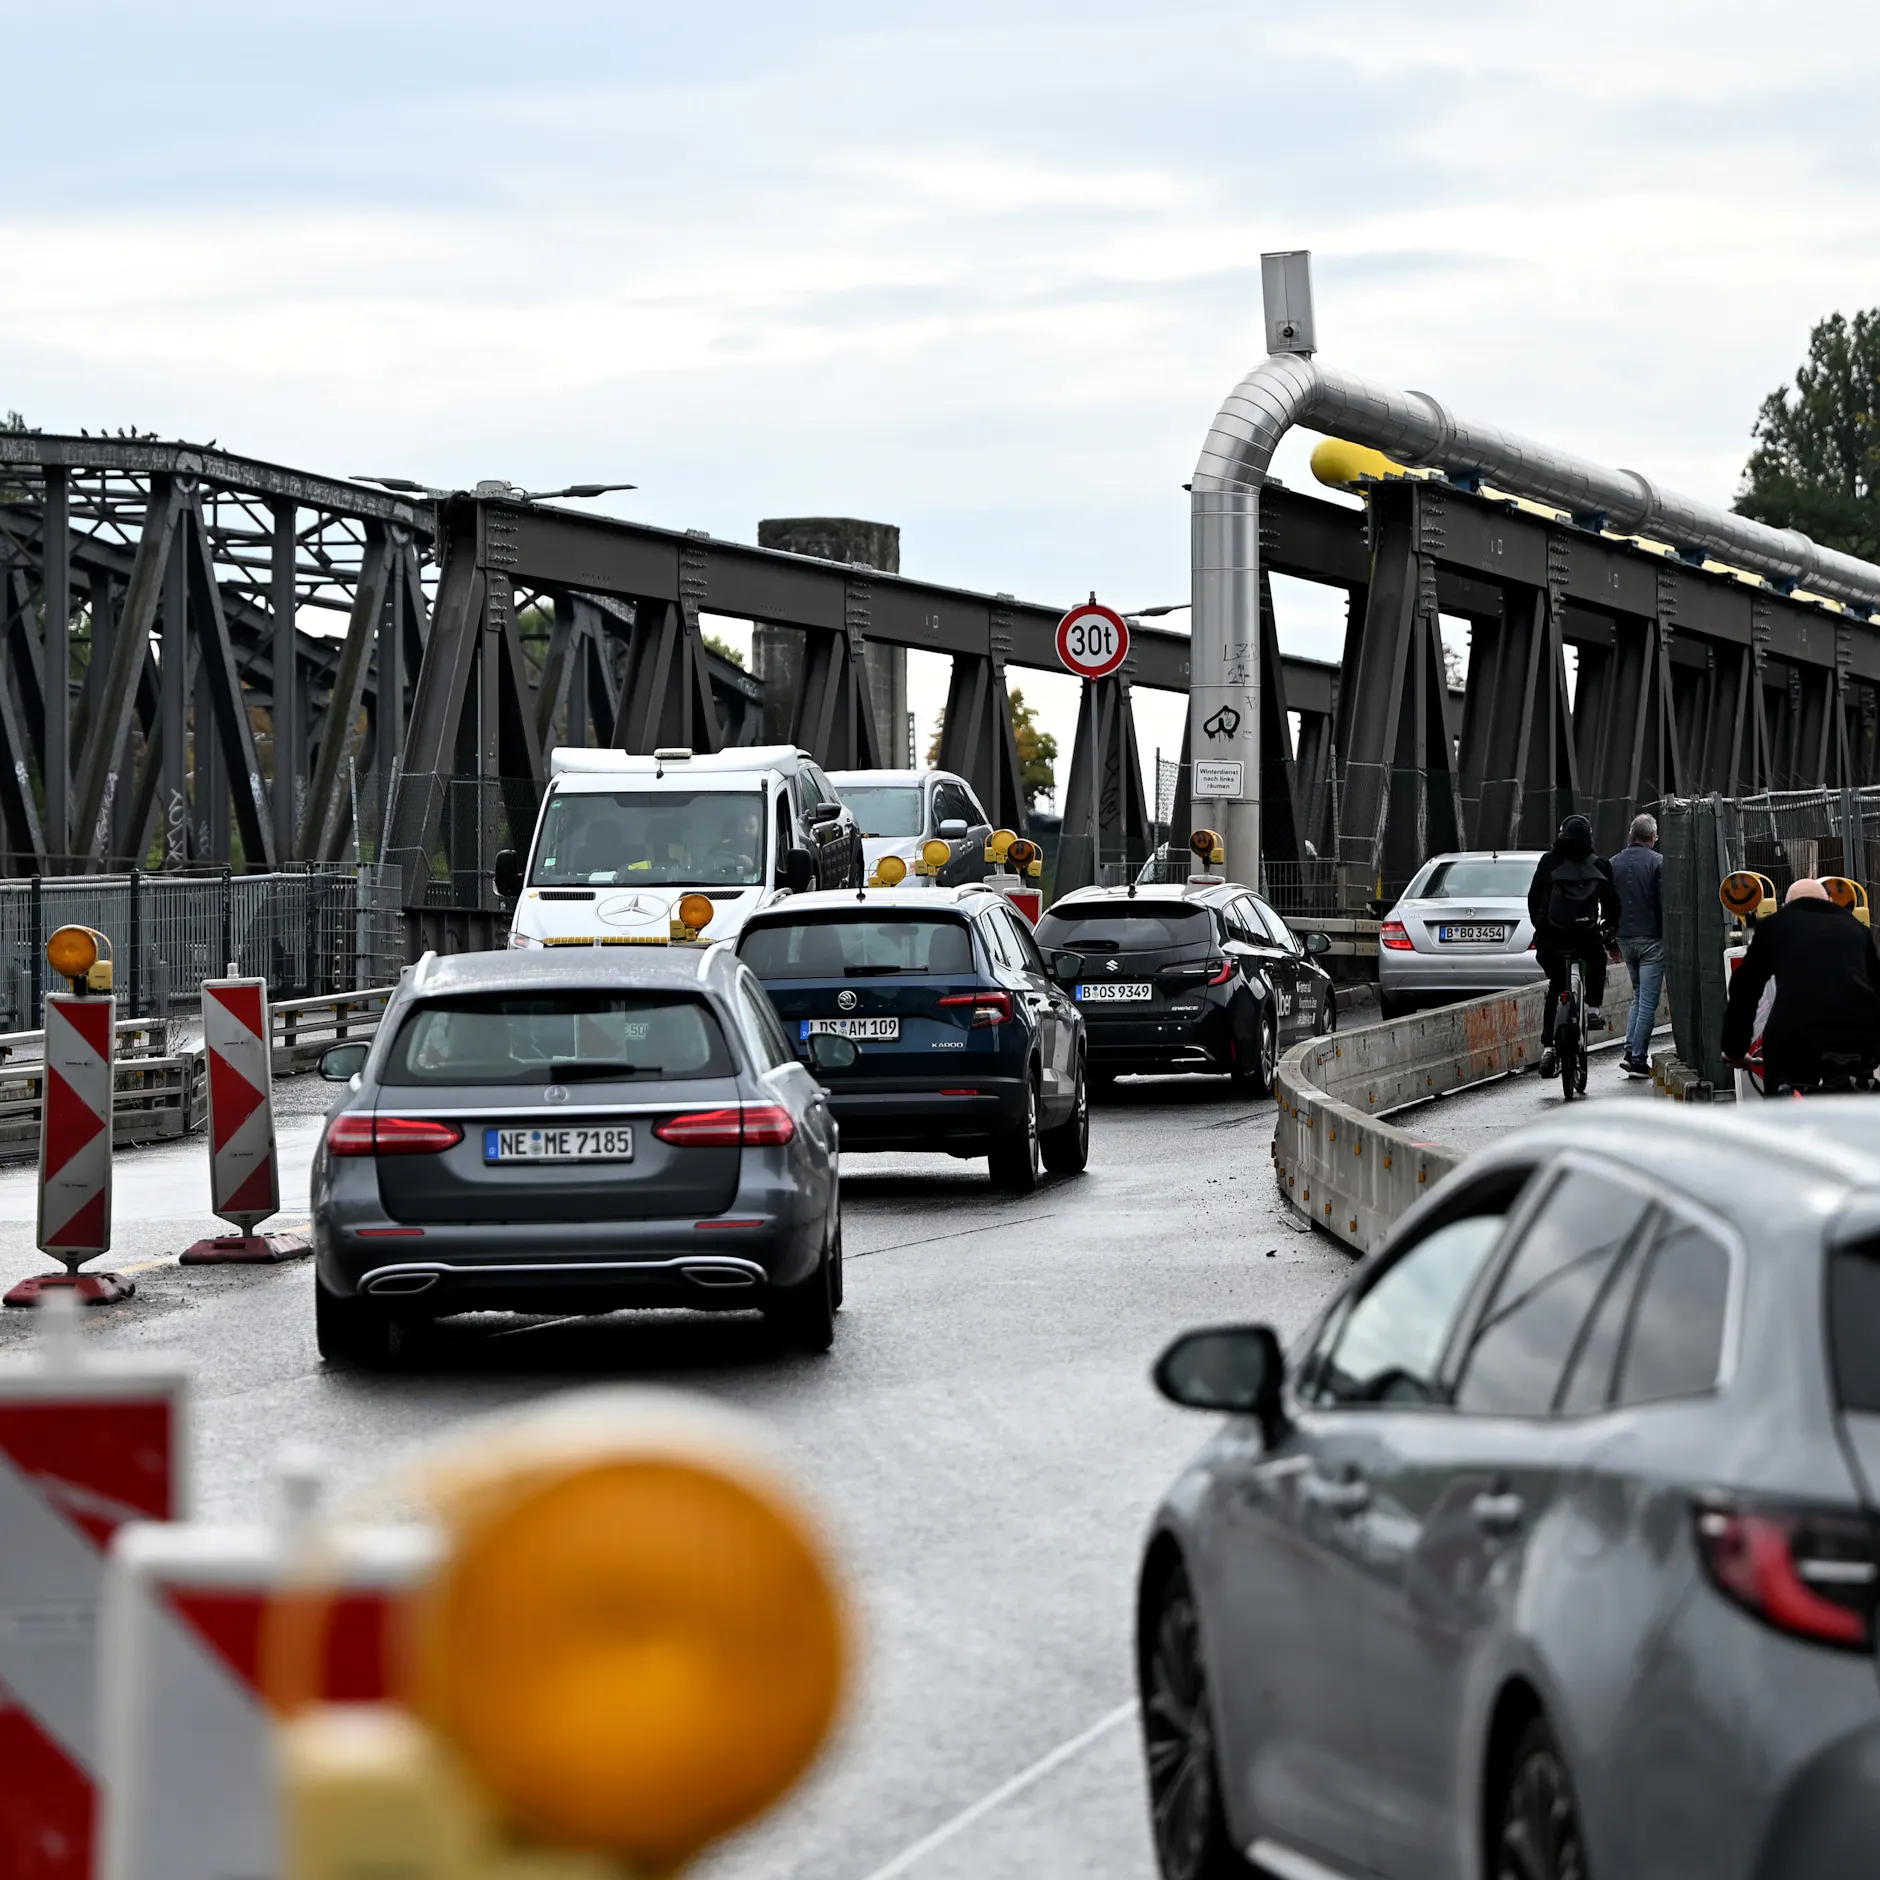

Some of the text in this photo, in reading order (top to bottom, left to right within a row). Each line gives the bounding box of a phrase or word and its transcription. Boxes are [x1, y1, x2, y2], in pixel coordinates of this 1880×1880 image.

[1071, 625, 1112, 656] 30t
[1200, 768, 1239, 776] Winterdienst
[1446, 928, 1453, 938] B
[1476, 927, 1502, 938] 3454
[1083, 985, 1149, 998] B OS 9349
[1274, 987, 1292, 1017] Uber
[849, 1023, 867, 1035] AM
[871, 1019, 897, 1035] 109
[500, 1132, 527, 1155] NE
[544, 1131, 570, 1155] ME
[576, 1130, 629, 1154] 7185
